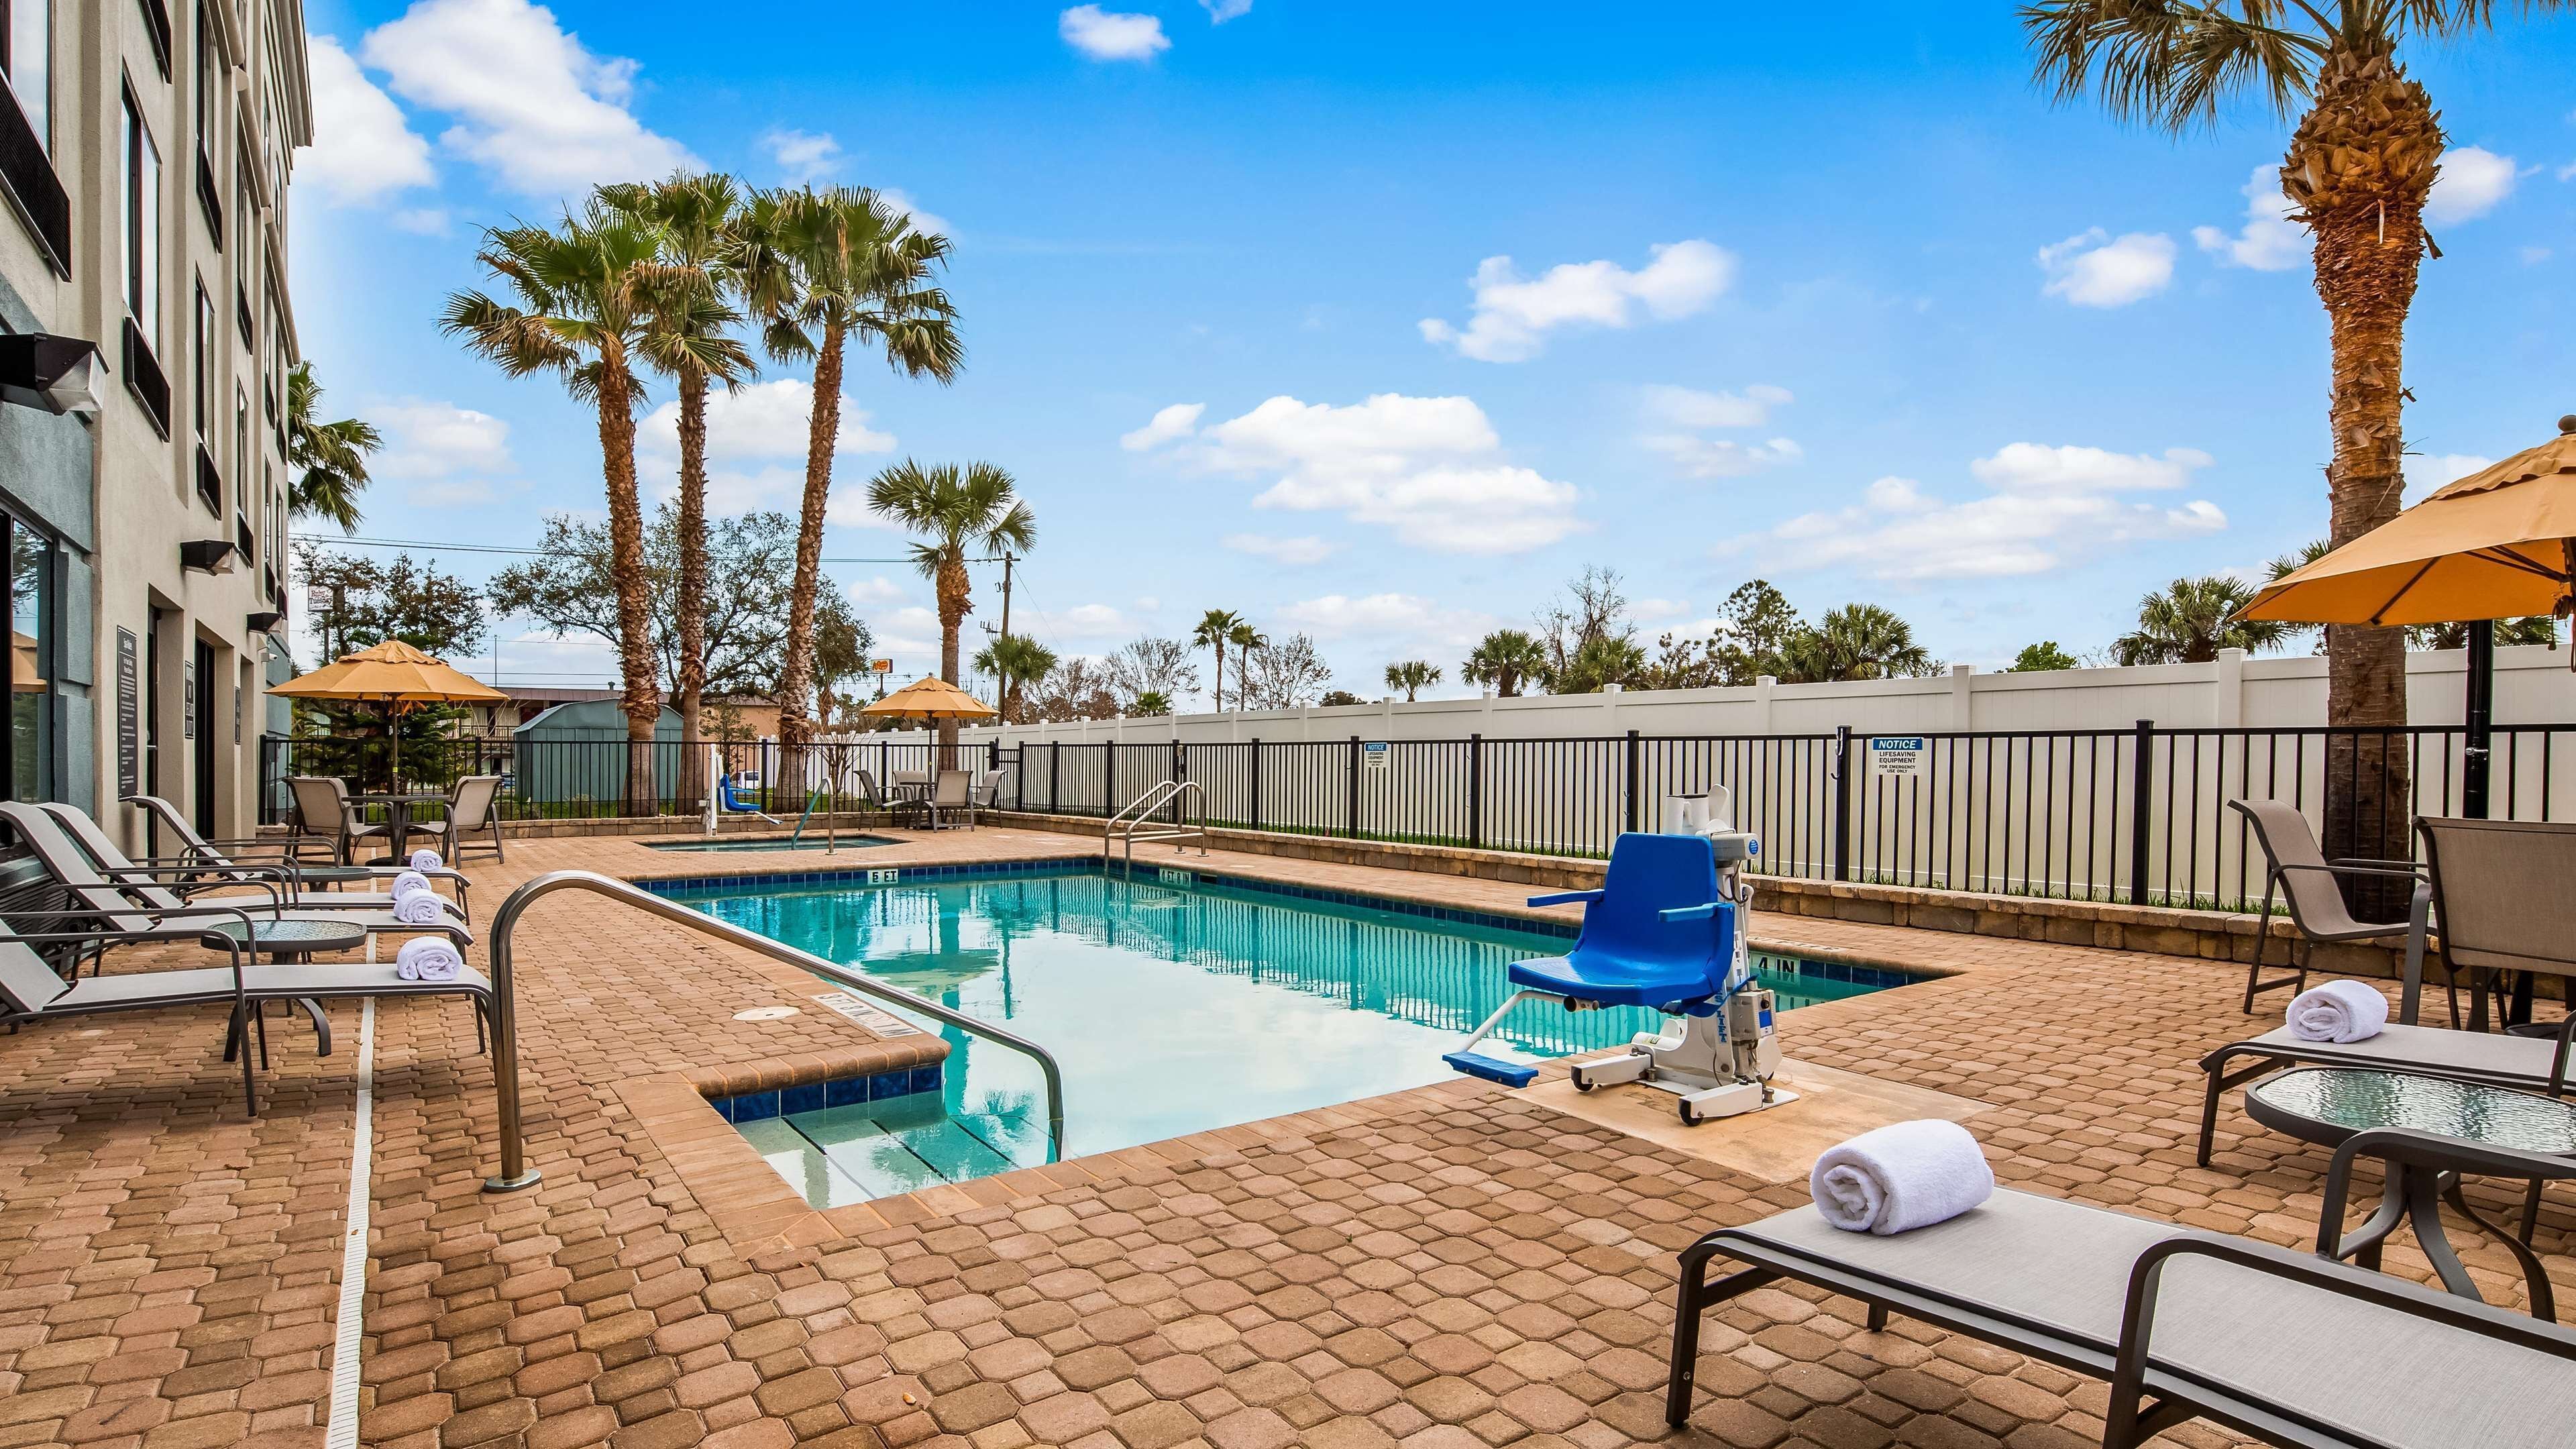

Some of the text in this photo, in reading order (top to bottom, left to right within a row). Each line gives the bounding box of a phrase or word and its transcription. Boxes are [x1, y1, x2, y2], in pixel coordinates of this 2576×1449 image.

[311, 590, 325, 598] Ruby
[1878, 740, 1917, 749] NOTICE
[1758, 956, 1794, 974] 4 IN
[829, 998, 856, 1008] FT
[846, 1009, 878, 1018] IN
[879, 1028, 918, 1037] M
[1716, 1010, 1727, 1042] LIFT
